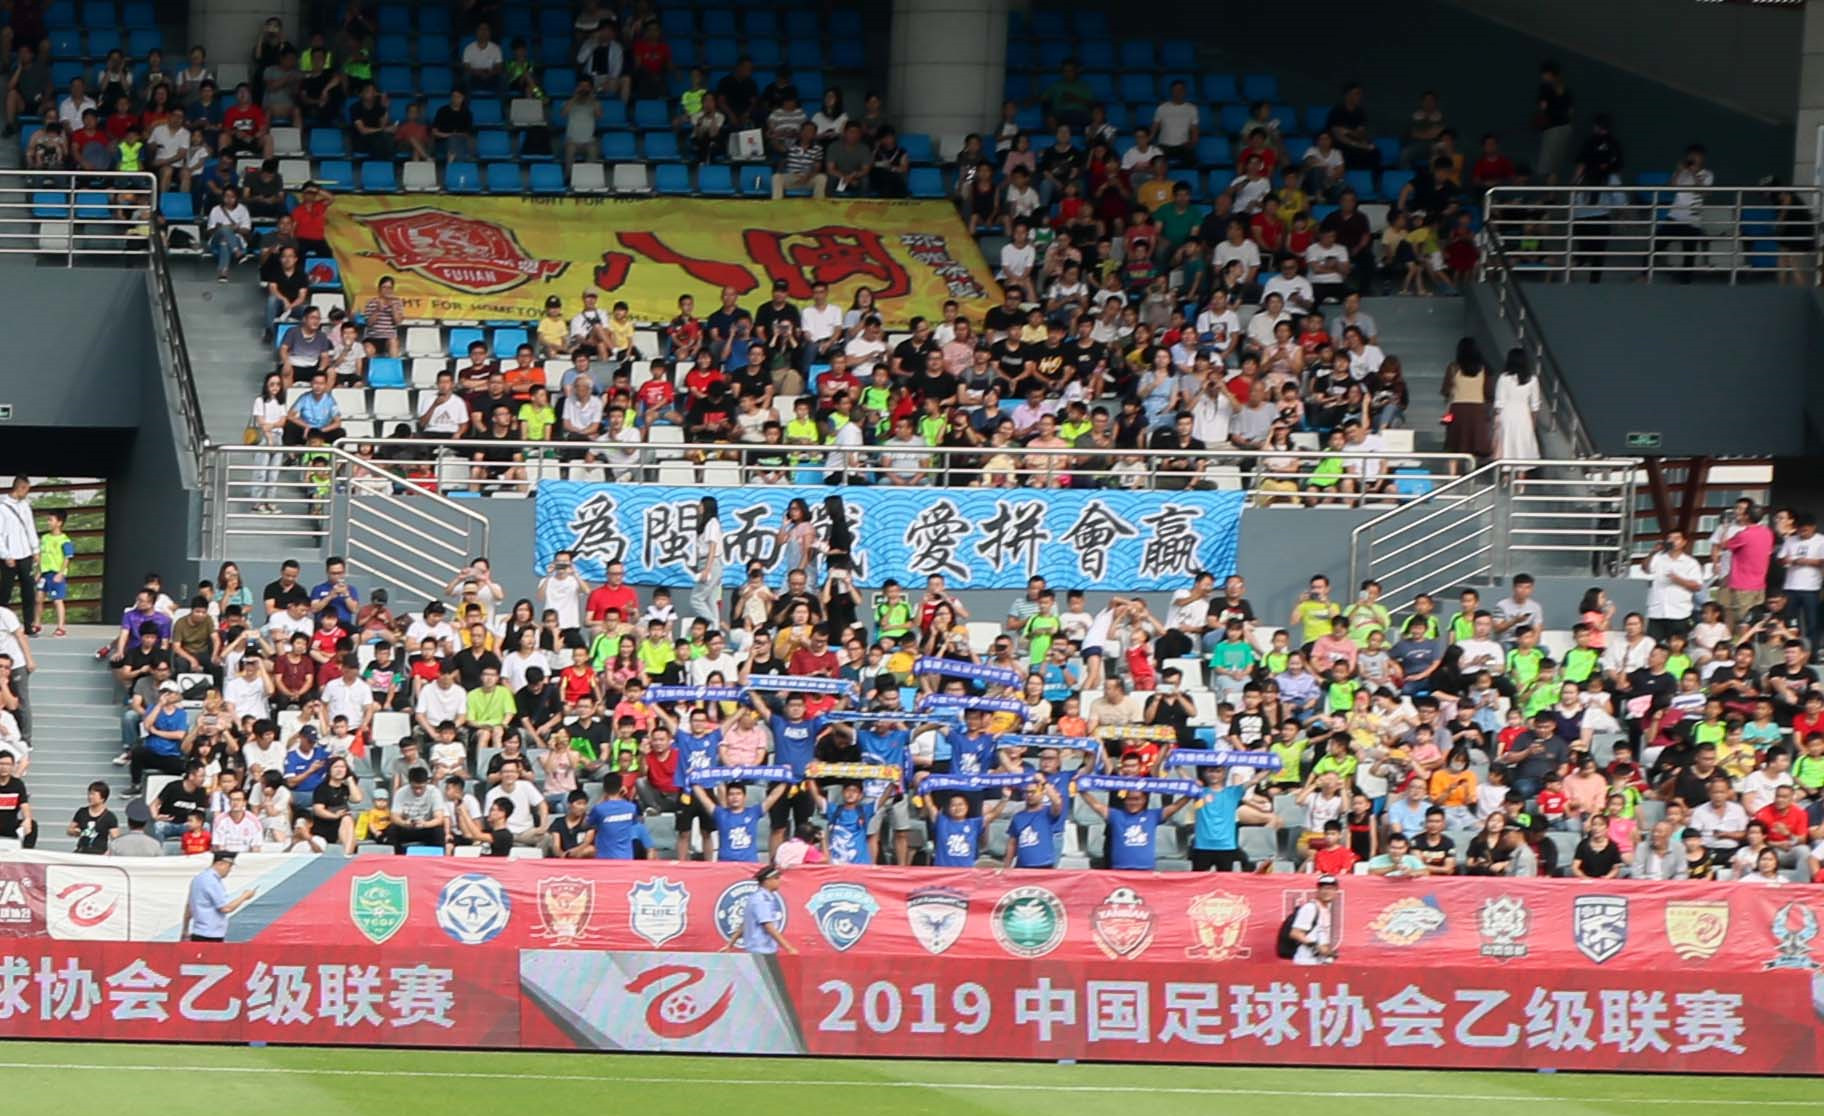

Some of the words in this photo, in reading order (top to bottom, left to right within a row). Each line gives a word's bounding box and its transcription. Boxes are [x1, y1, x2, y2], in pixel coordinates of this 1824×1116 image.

[818, 980, 991, 1036] 2019
[1014, 977, 1748, 1055] 中国足球协会乙级联赛
